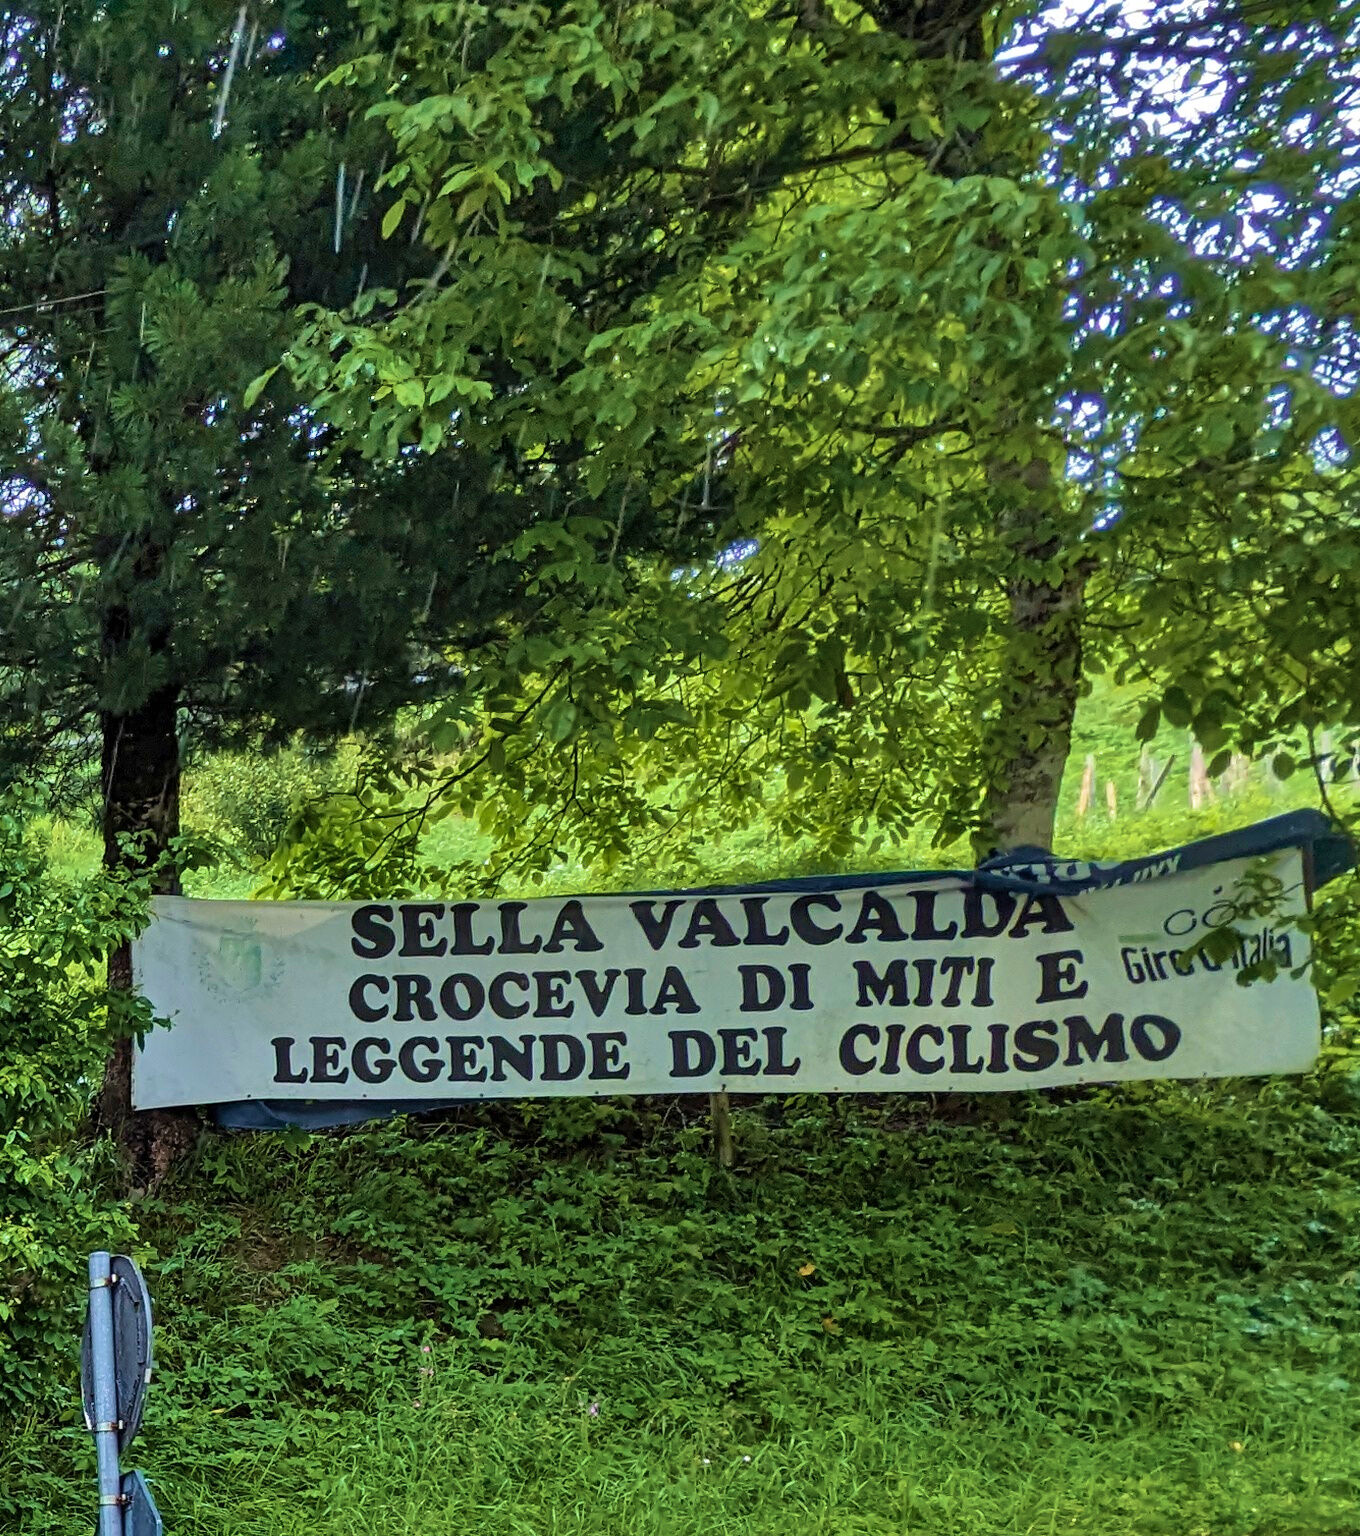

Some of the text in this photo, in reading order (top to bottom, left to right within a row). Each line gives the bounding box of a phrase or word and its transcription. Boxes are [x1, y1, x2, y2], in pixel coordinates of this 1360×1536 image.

[351, 889, 1075, 959] SELLA VALCALDA
[348, 949, 1089, 1023] CROCEVIA DI MITI E
[270, 1012, 1182, 1085] LEGGENDE DEL CICLISMO
